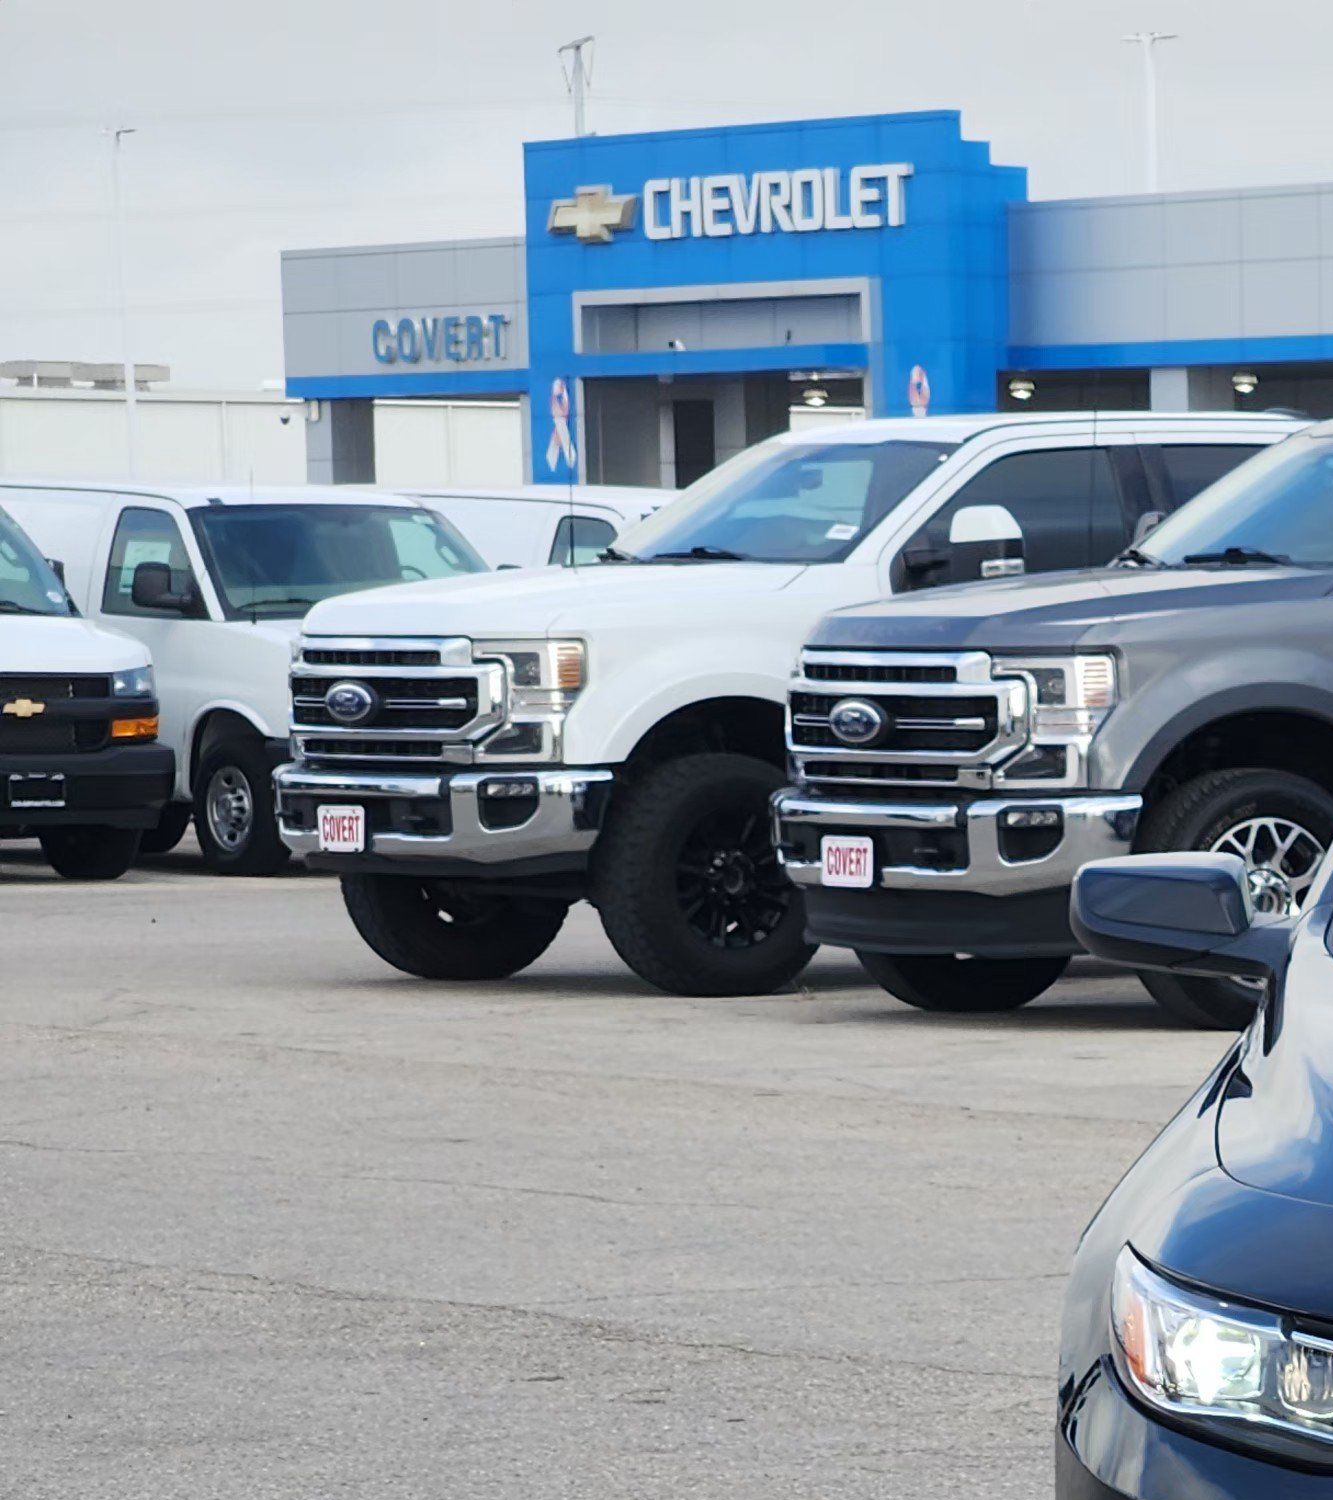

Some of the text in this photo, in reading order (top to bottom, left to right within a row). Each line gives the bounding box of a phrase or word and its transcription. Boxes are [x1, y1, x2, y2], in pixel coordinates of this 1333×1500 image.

[644, 162, 914, 240] CHEVROLET
[372, 313, 511, 365] COVERT
[322, 815, 360, 842] COVERT
[826, 846, 868, 877] COVERT
